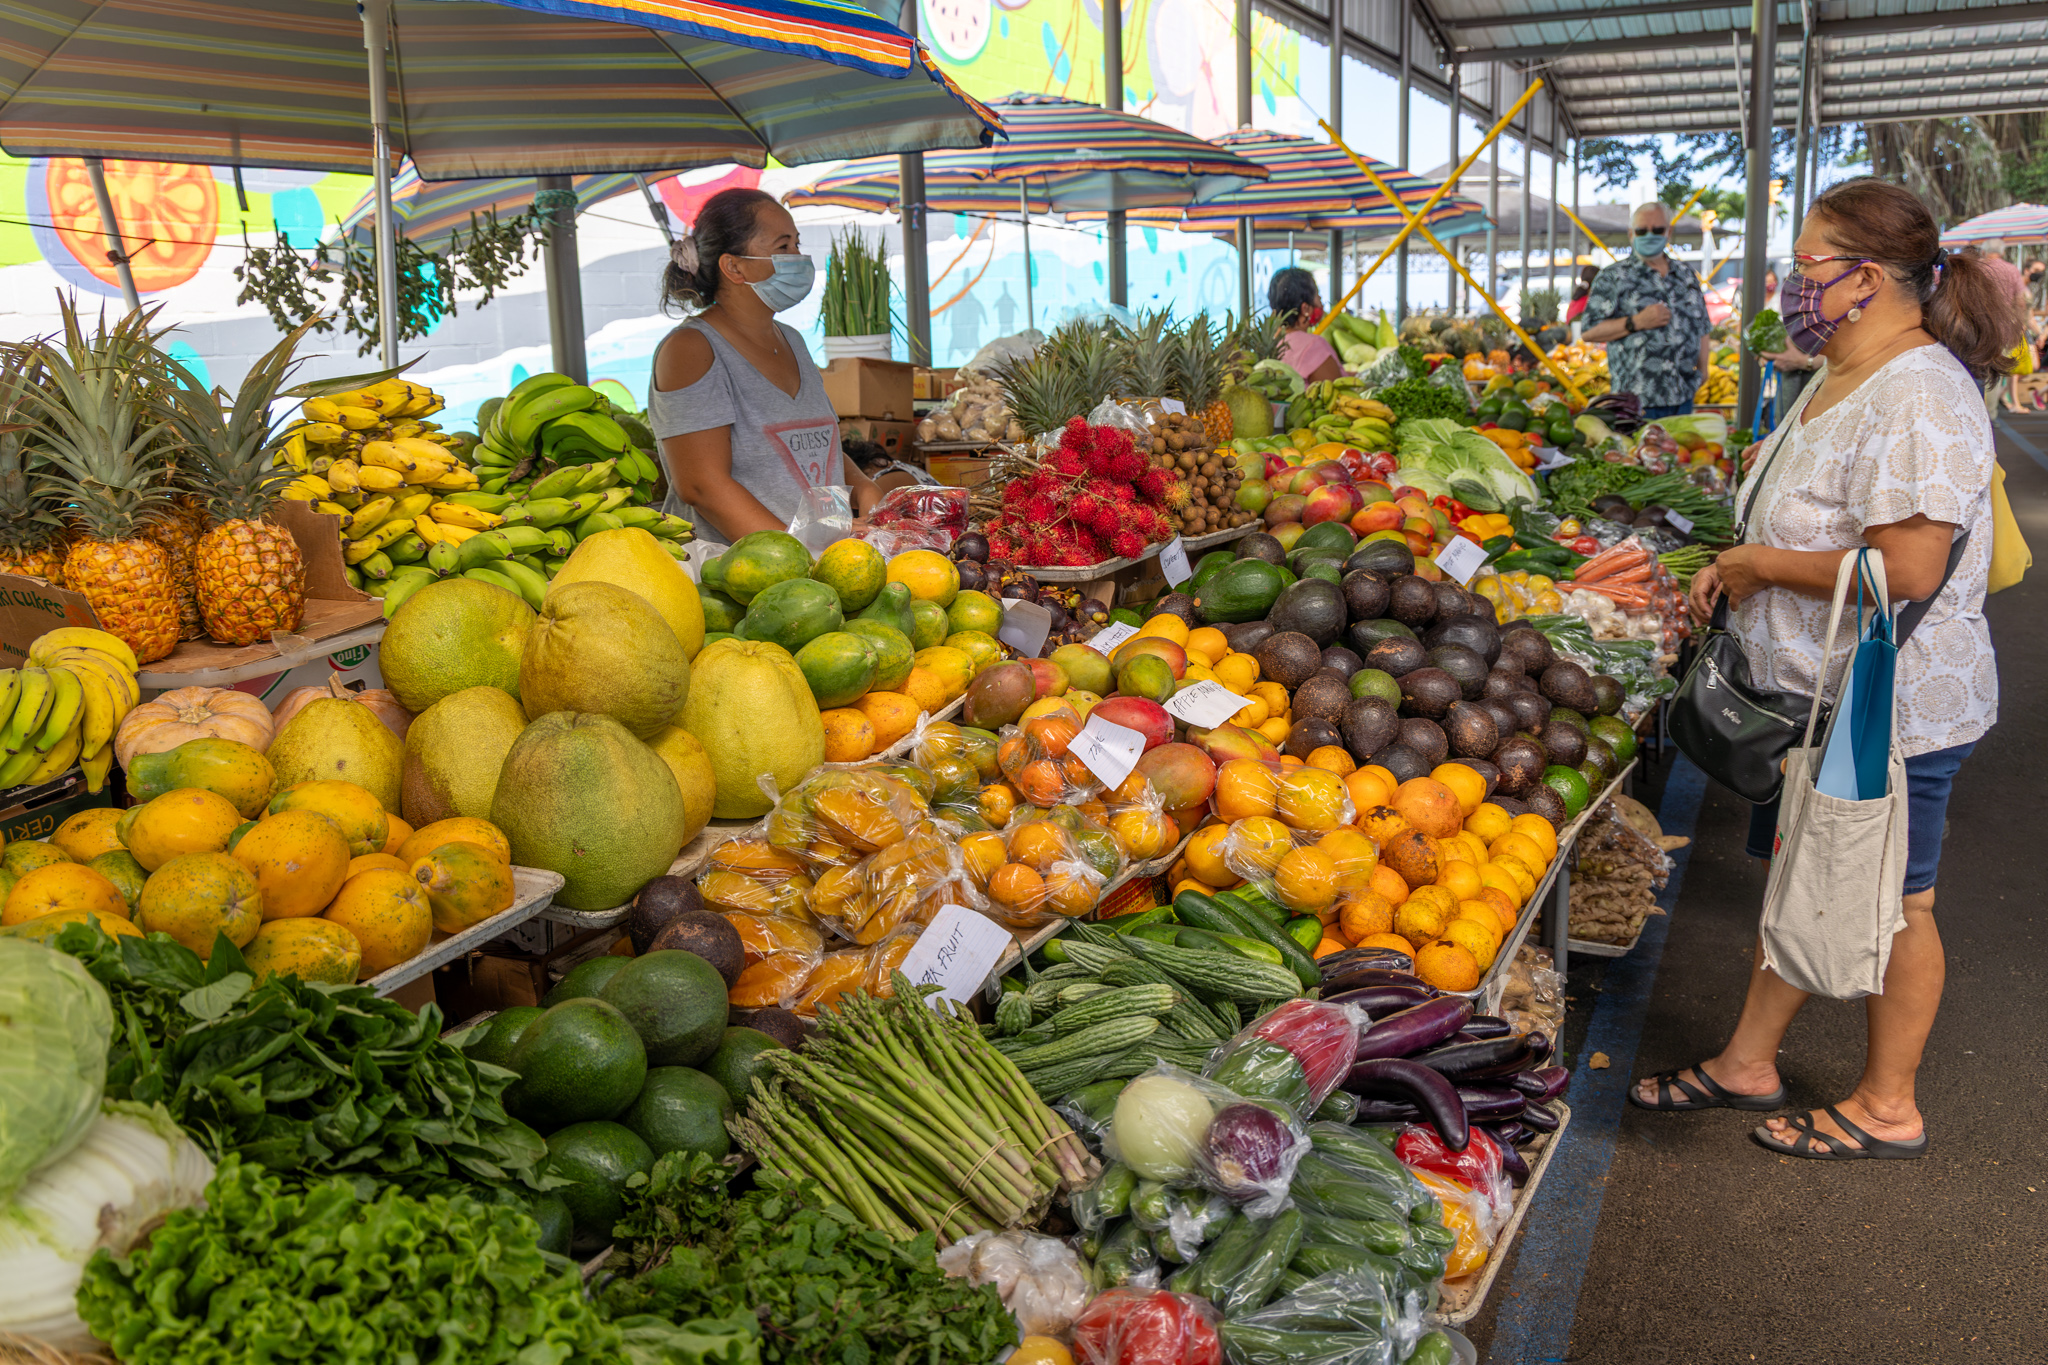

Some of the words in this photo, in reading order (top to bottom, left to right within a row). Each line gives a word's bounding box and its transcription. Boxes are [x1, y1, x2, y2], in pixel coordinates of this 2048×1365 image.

[790, 431, 829, 451] GUESS
[337, 646, 364, 663] Fino
[1173, 688, 1198, 716] APPLE
[937, 922, 963, 970] FRUIT
